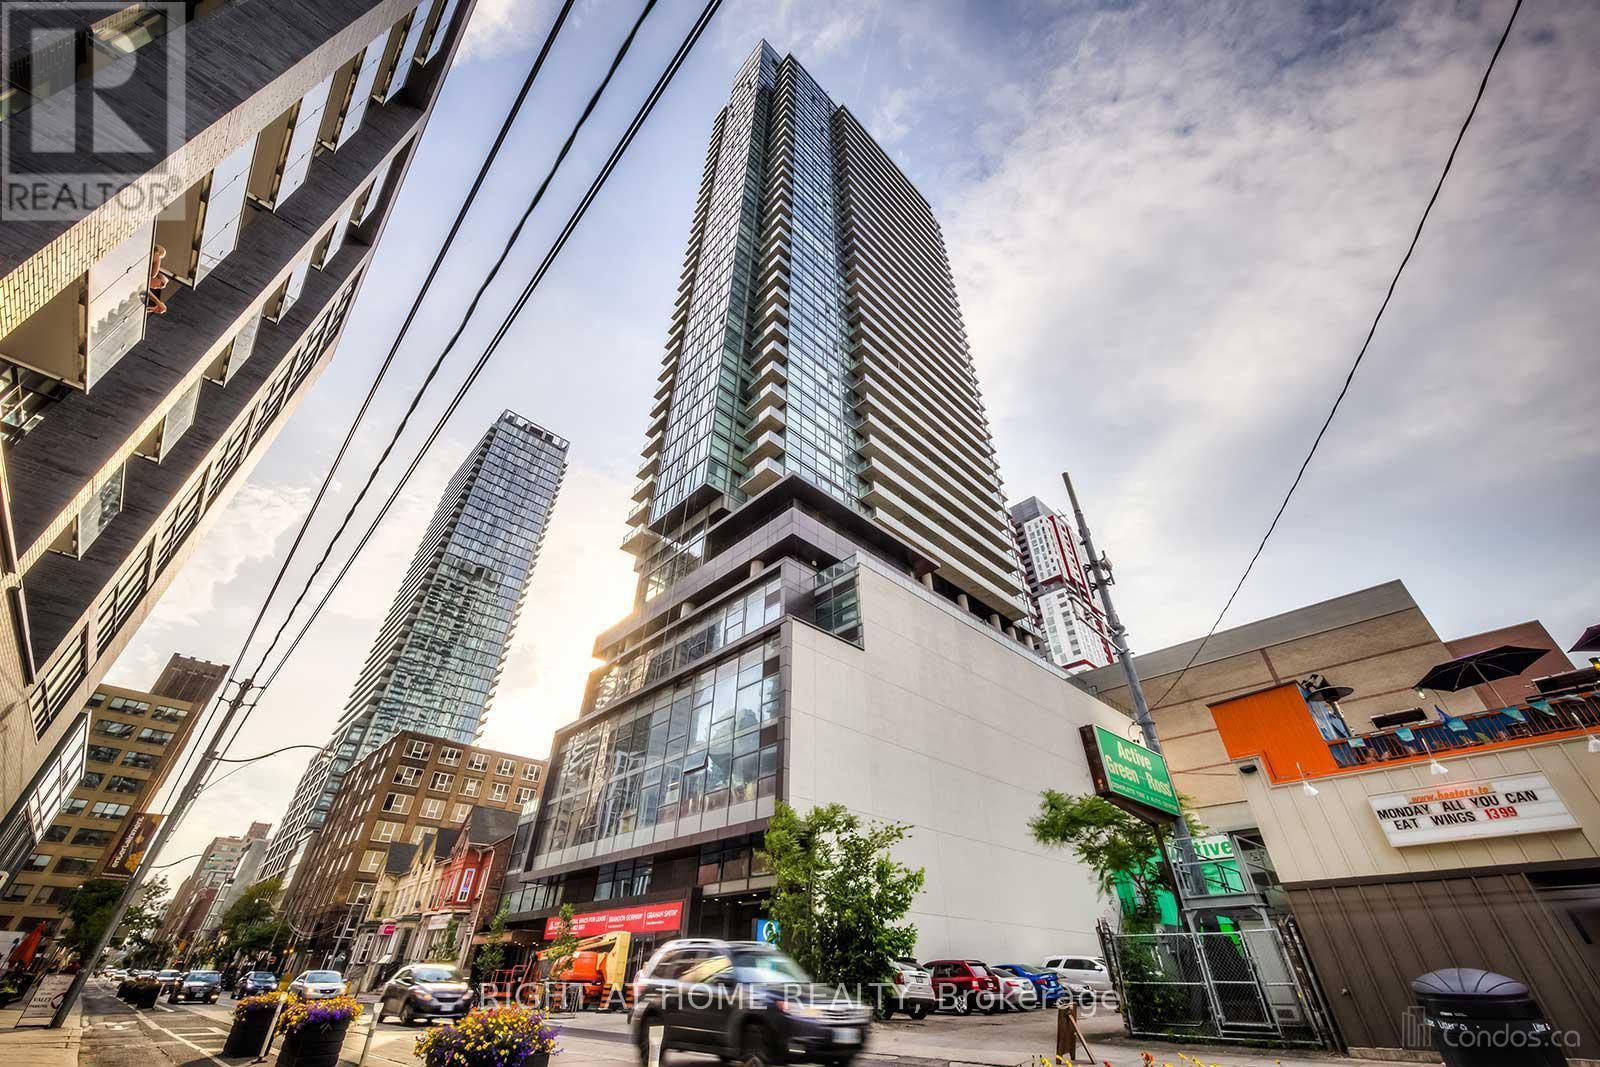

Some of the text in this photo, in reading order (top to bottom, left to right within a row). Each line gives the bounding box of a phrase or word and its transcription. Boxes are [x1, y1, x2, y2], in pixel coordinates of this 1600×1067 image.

[1117, 740, 1152, 771] Active
[1104, 754, 1173, 797] Green Ross
[1377, 789, 1538, 821] MONDAY ALL YOU CAN
[1411, 785, 1489, 803] www.hooters.to
[1393, 806, 1518, 831] EAT WINGS 1399
